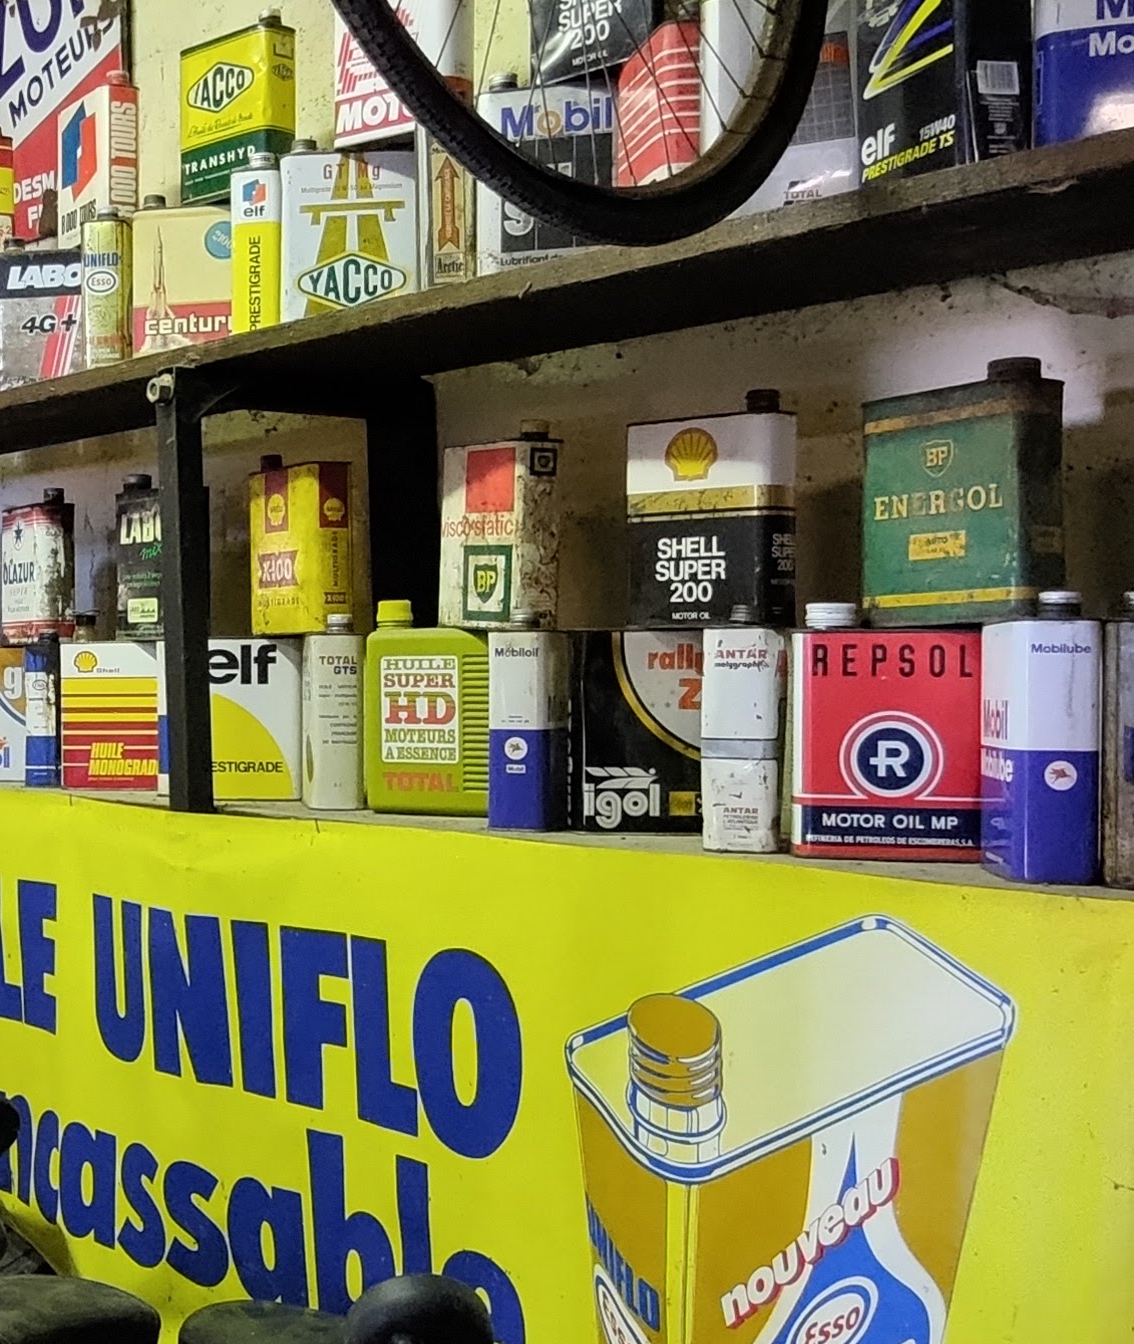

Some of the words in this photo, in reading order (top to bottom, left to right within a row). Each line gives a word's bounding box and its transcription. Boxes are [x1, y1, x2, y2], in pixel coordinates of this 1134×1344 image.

[570, 18, 610, 51] 200
[111, 100, 138, 159] TOURS
[501, 96, 612, 142] Mobil
[919, 114, 956, 143] 15W40
[861, 123, 895, 166] elf
[862, 139, 936, 184] PRESTIGRADE
[938, 129, 956, 150] TS
[184, 144, 256, 176] TRANSHYD
[243, 205, 266, 217] elf
[248, 234, 262, 333] PRESTIGRADE
[309, 258, 393, 304] YACCO
[926, 446, 948, 467] BP
[873, 482, 1004, 523] ENERGOL
[119, 510, 161, 546] LAB
[657, 535, 726, 559] SHELL
[476, 569, 497, 594] BP
[654, 558, 727, 583] SUPER
[669, 581, 713, 604] 200
[319, 656, 358, 665] TOTAL
[494, 646, 540, 659] Mobiloil
[714, 647, 768, 660] ANTAR
[812, 643, 974, 679] REPSOL
[1030, 642, 1092, 655] Mobilube
[209, 643, 278, 685] elf
[333, 665, 358, 675] GTS
[383, 658, 456, 671] HUILE
[383, 674, 456, 690] SUPER
[383, 692, 457, 725] HD
[384, 728, 456, 745] MOTEURS
[90, 742, 125, 759] HUILE
[385, 747, 395, 760] A
[396, 746, 457, 761] ESSENCE
[382, 771, 459, 793] TOTAL
[583, 781, 662, 830] igol
[821, 813, 885, 829] MOTOR
[892, 814, 925, 830] OIL
[931, 816, 959, 830] MP
[92, 891, 525, 1160] UNIFLO
[720, 1157, 902, 1330] nouveau
